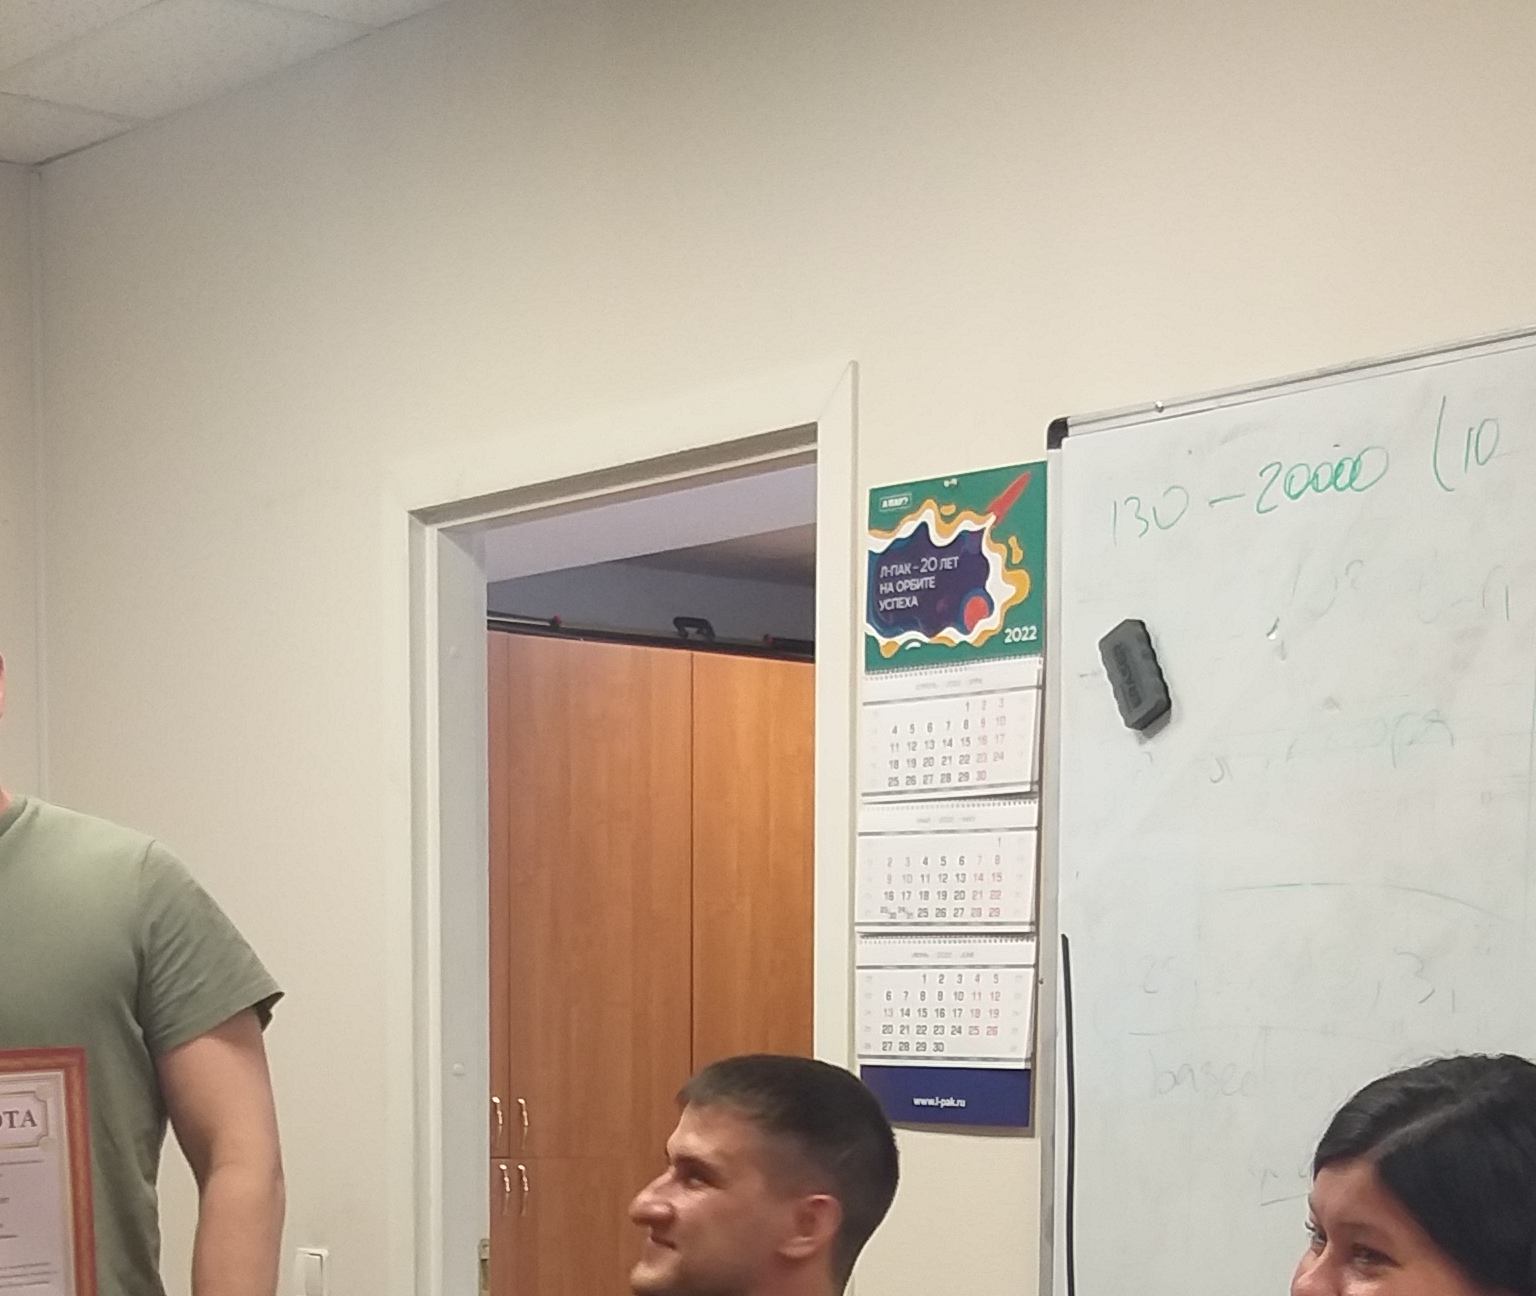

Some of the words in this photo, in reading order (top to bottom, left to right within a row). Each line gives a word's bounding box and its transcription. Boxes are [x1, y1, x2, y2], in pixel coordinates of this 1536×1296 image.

[880, 563, 911, 578] Л-ПАК
[920, 557, 937, 572] 20
[939, 556, 959, 570] ЛЕТ
[880, 583, 894, 594] НА
[896, 576, 935, 593] ОРБИТЕ
[879, 596, 918, 611] УСПЕХА
[1004, 626, 1037, 643] 2022
[965, 701, 970, 711] 1
[892, 725, 897, 734] 4
[910, 724, 915, 734] 5
[927, 722, 933, 733] 6
[946, 721, 951, 730] 7
[964, 719, 969, 729] 8
[981, 718, 985, 728] 9
[996, 716, 1006, 726] 10
[890, 743, 899, 753] 11
[907, 741, 917, 751] 12
[924, 740, 935, 750] 13
[942, 738, 953, 748] 14
[961, 737, 970, 747] 15
[978, 735, 987, 745] 16
[995, 734, 1005, 743] 17
[889, 760, 899, 769] 18
[907, 758, 916, 768] 19
[923, 757, 934, 767] 20
[941, 756, 952, 765] 21
[959, 754, 970, 765] 22
[977, 753, 987, 763] 23
[993, 752, 1004, 762] 24
[888, 777, 899, 787] 25
[905, 775, 916, 785] 26
[923, 774, 933, 785] 27
[940, 773, 951, 783] 28
[958, 772, 969, 782] 29
[976, 771, 986, 780] 30
[997, 837, 1001, 847] 1
[887, 857, 893, 866] 2
[905, 857, 910, 866] 3
[923, 856, 928, 866] 4
[941, 856, 946, 866] 5
[959, 856, 965, 866] 6
[977, 855, 982, 865] 7
[995, 855, 1000, 865] 8
[887, 875, 892, 884] 9
[903, 874, 912, 883] 10
[920, 874, 930, 883] 11
[938, 874, 948, 883] 12
[956, 873, 966, 883] 13
[973, 873, 984, 882] 14
[992, 872, 1002, 882] 15
[884, 892, 894, 901] 16
[901, 891, 911, 900] 17
[919, 891, 929, 900] 18
[937, 891, 947, 900] 19
[954, 891, 965, 900] 20
[972, 890, 982, 900] 21
[990, 890, 1001, 900] 22
[918, 908, 928, 918] 25
[935, 908, 946, 917] 26
[953, 908, 964, 917] 27
[971, 908, 982, 917] 28
[989, 908, 1000, 917] 29
[922, 974, 926, 983] 1
[938, 974, 944, 984] 2
[957, 974, 962, 983] 3
[975, 974, 980, 983] 4
[994, 974, 998, 983] 5
[886, 991, 891, 1001] 6
[904, 991, 908, 1001] 7
[920, 991, 926, 1001] 8
[938, 991, 943, 1001] 9
[953, 991, 964, 1001] 10
[971, 991, 981, 1000] 11
[990, 991, 1001, 1001] 12
[884, 1009, 893, 1017] 13
[900, 1008, 910, 1017] 14
[917, 1008, 927, 1018] 15
[935, 1008, 945, 1018] 16
[953, 1009, 963, 1018] 17
[970, 1009, 980, 1018] 18
[989, 1009, 999, 1018] 19
[882, 1025, 893, 1035] 20
[900, 1025, 910, 1035] 21
[916, 1025, 927, 1035] 22
[933, 1025, 944, 1035] 23
[951, 1026, 962, 1035] 24
[969, 1026, 979, 1035] 25
[986, 1026, 998, 1035] 26
[882, 1041, 893, 1051] 27
[899, 1042, 909, 1051] 28
[916, 1042, 927, 1052] 29
[933, 1042, 944, 1052] 30
